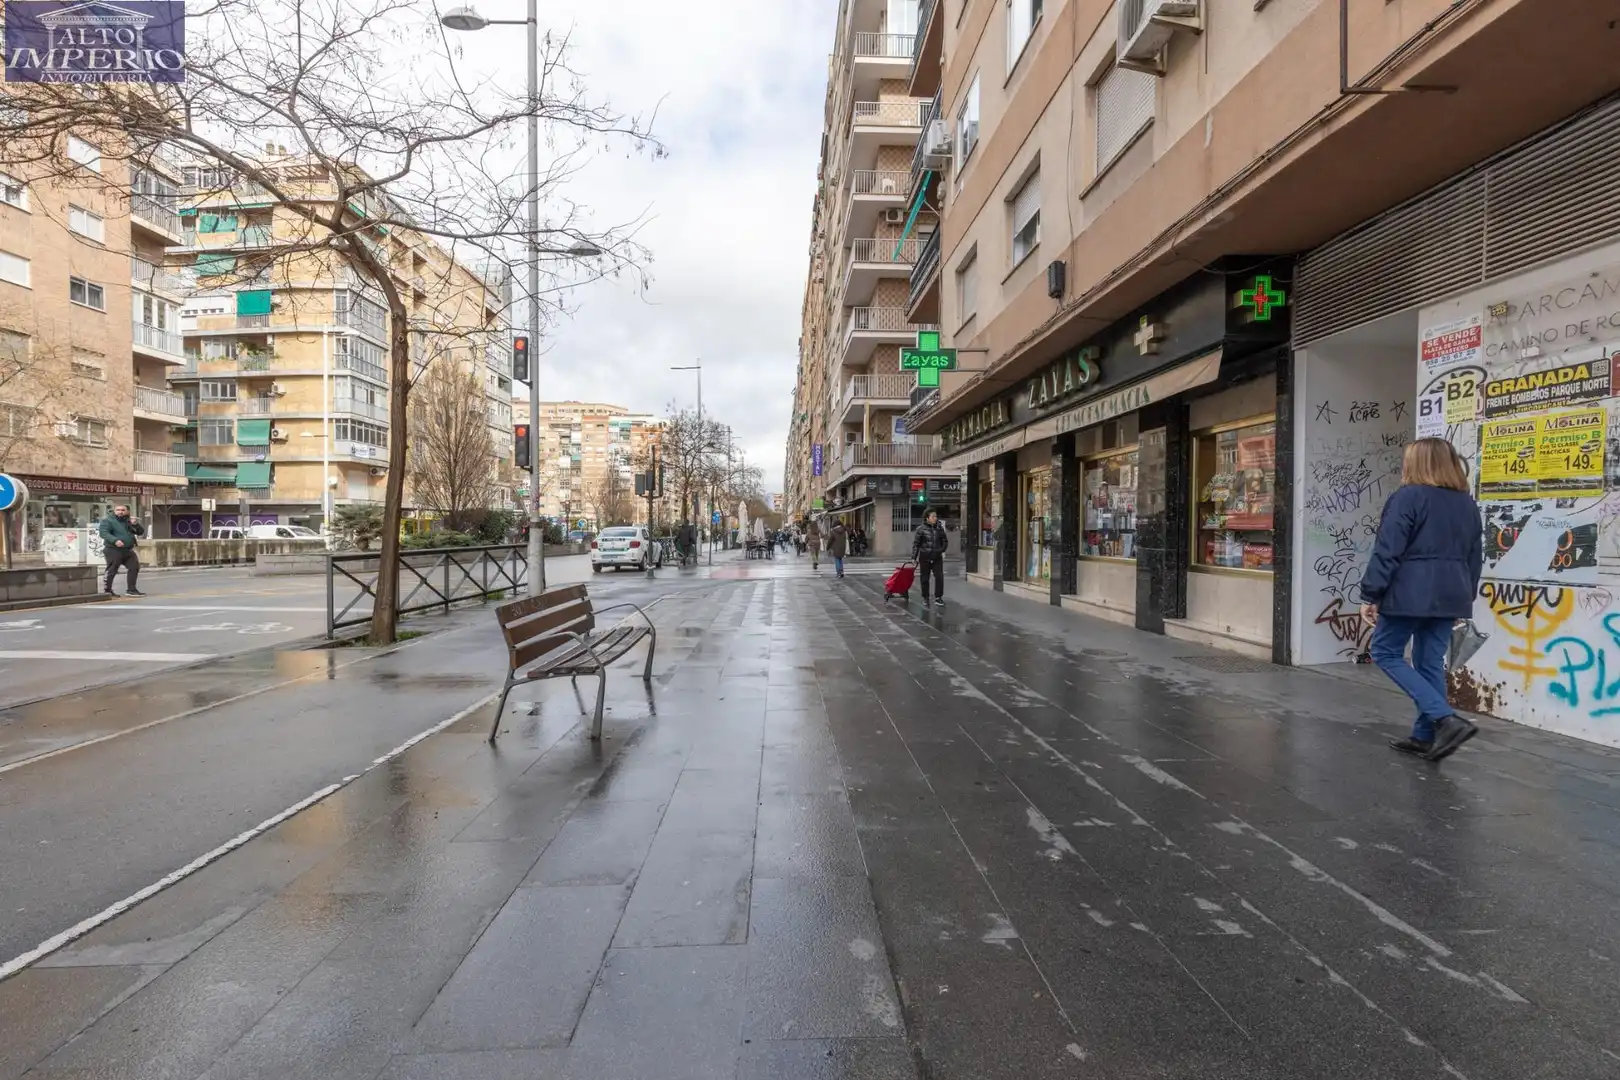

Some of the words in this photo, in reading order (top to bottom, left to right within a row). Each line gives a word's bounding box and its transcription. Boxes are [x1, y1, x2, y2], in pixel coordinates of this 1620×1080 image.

[1426, 339, 1439, 348] SE
[1441, 328, 1477, 343] VENDE
[1486, 328, 1558, 357] CAMINO
[1565, 319, 1590, 338] DE
[903, 352, 949, 367] Zayas
[1028, 348, 1096, 409] ZAYAS
[1487, 364, 1590, 397] GRANADA
[1447, 379, 1475, 401] B2
[1486, 395, 1510, 408] FRENTE
[1551, 383, 1581, 397] PARQUE
[1582, 377, 1609, 392] NORTE
[1419, 396, 1443, 416] B1
[949, 401, 1006, 446] FARMACIA
[1485, 438, 1524, 449] Permiso
[1528, 437, 1536, 446] B
[1542, 432, 1587, 445] Permiso
[1592, 430, 1601, 439] B
[25, 479, 62, 490] PRODUCTOS
